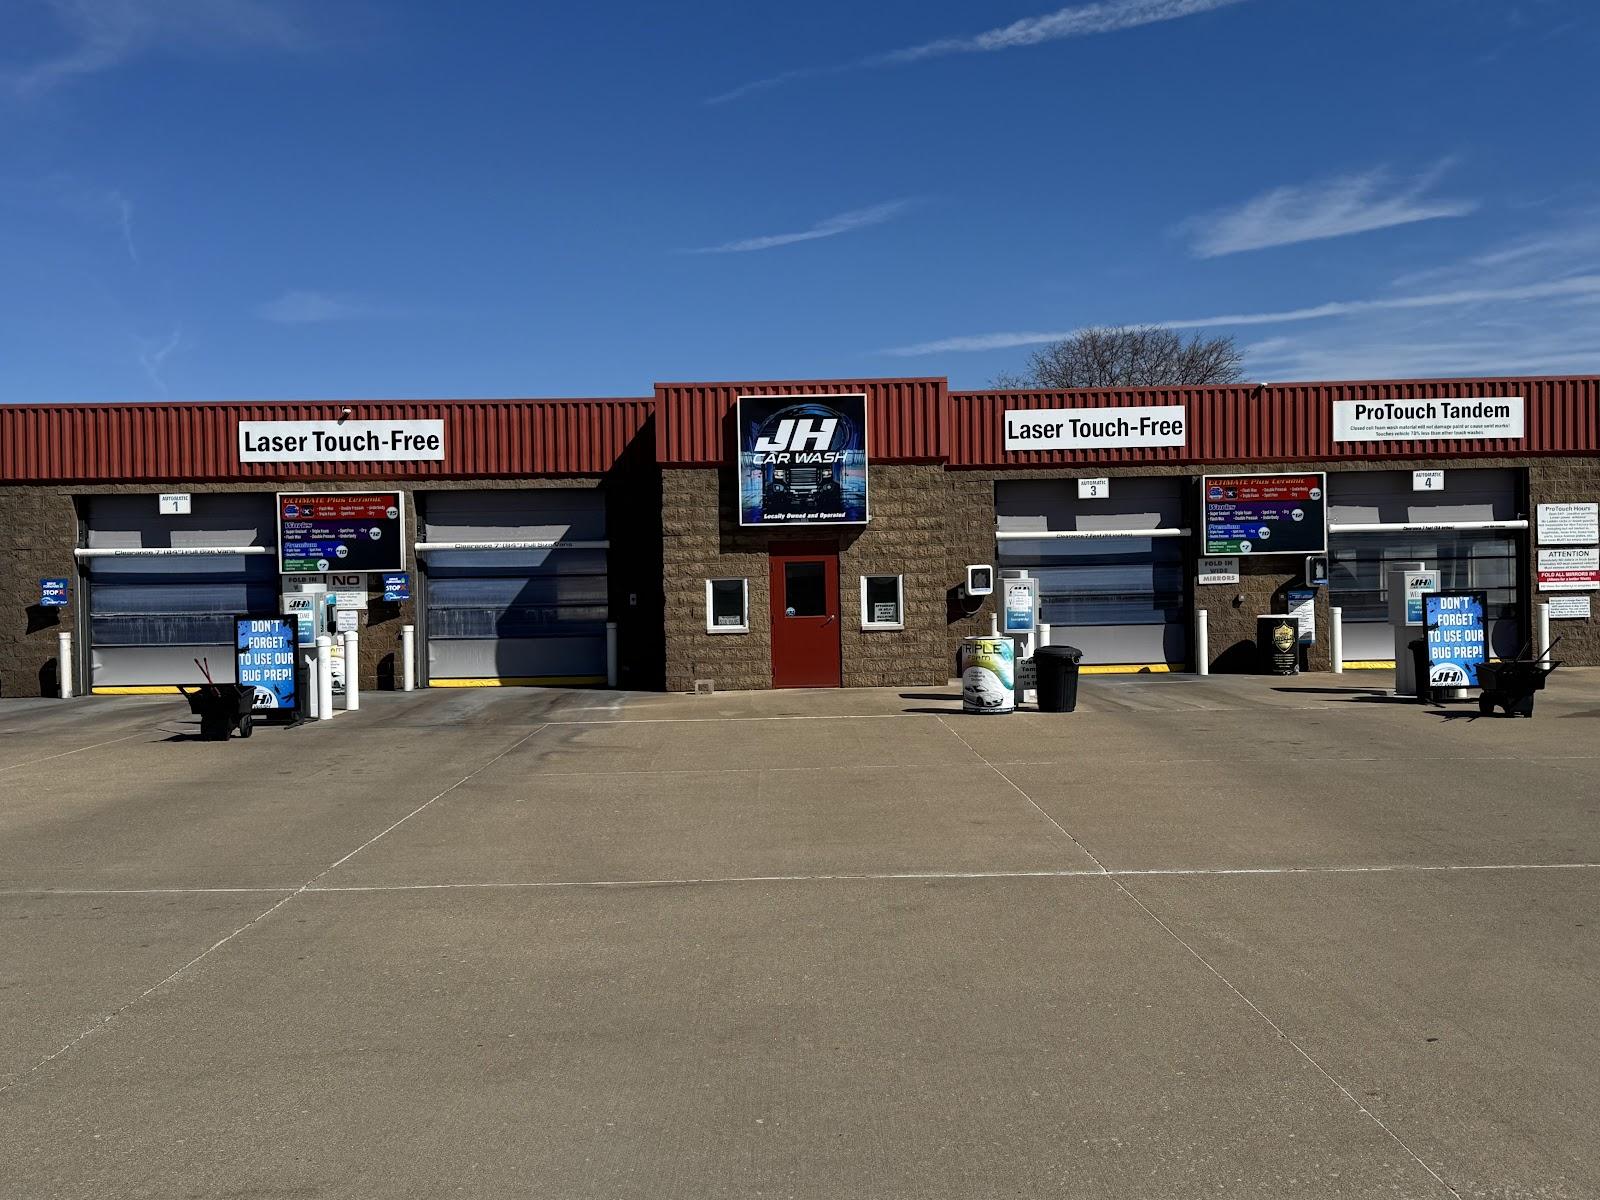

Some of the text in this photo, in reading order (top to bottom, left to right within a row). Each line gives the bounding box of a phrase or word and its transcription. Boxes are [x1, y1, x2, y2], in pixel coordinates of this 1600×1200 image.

[1355, 402, 1510, 420] ProTouch Tandem
[754, 418, 838, 451] JH
[1008, 417, 1183, 440] Laser Touch-Free
[245, 430, 440, 452] Laser Touch-Free
[753, 452, 847, 464] CAR WASH
[1425, 477, 1432, 488] 4
[1090, 486, 1097, 496] 3
[173, 501, 178, 511] 1
[333, 576, 359, 585] NO
[1440, 597, 1469, 609] DON'T
[1437, 613, 1474, 626] FORGET
[251, 620, 280, 632] DON'T
[1428, 629, 1484, 643] TO USE OUR
[249, 636, 283, 649] FORGET
[962, 644, 1002, 655] TRIPLE
[1432, 645, 1482, 659] BUG PREP!
[239, 653, 294, 665] TO USE OUR
[242, 668, 291, 681] BUG PREP!
[1432, 671, 1458, 682] JH
